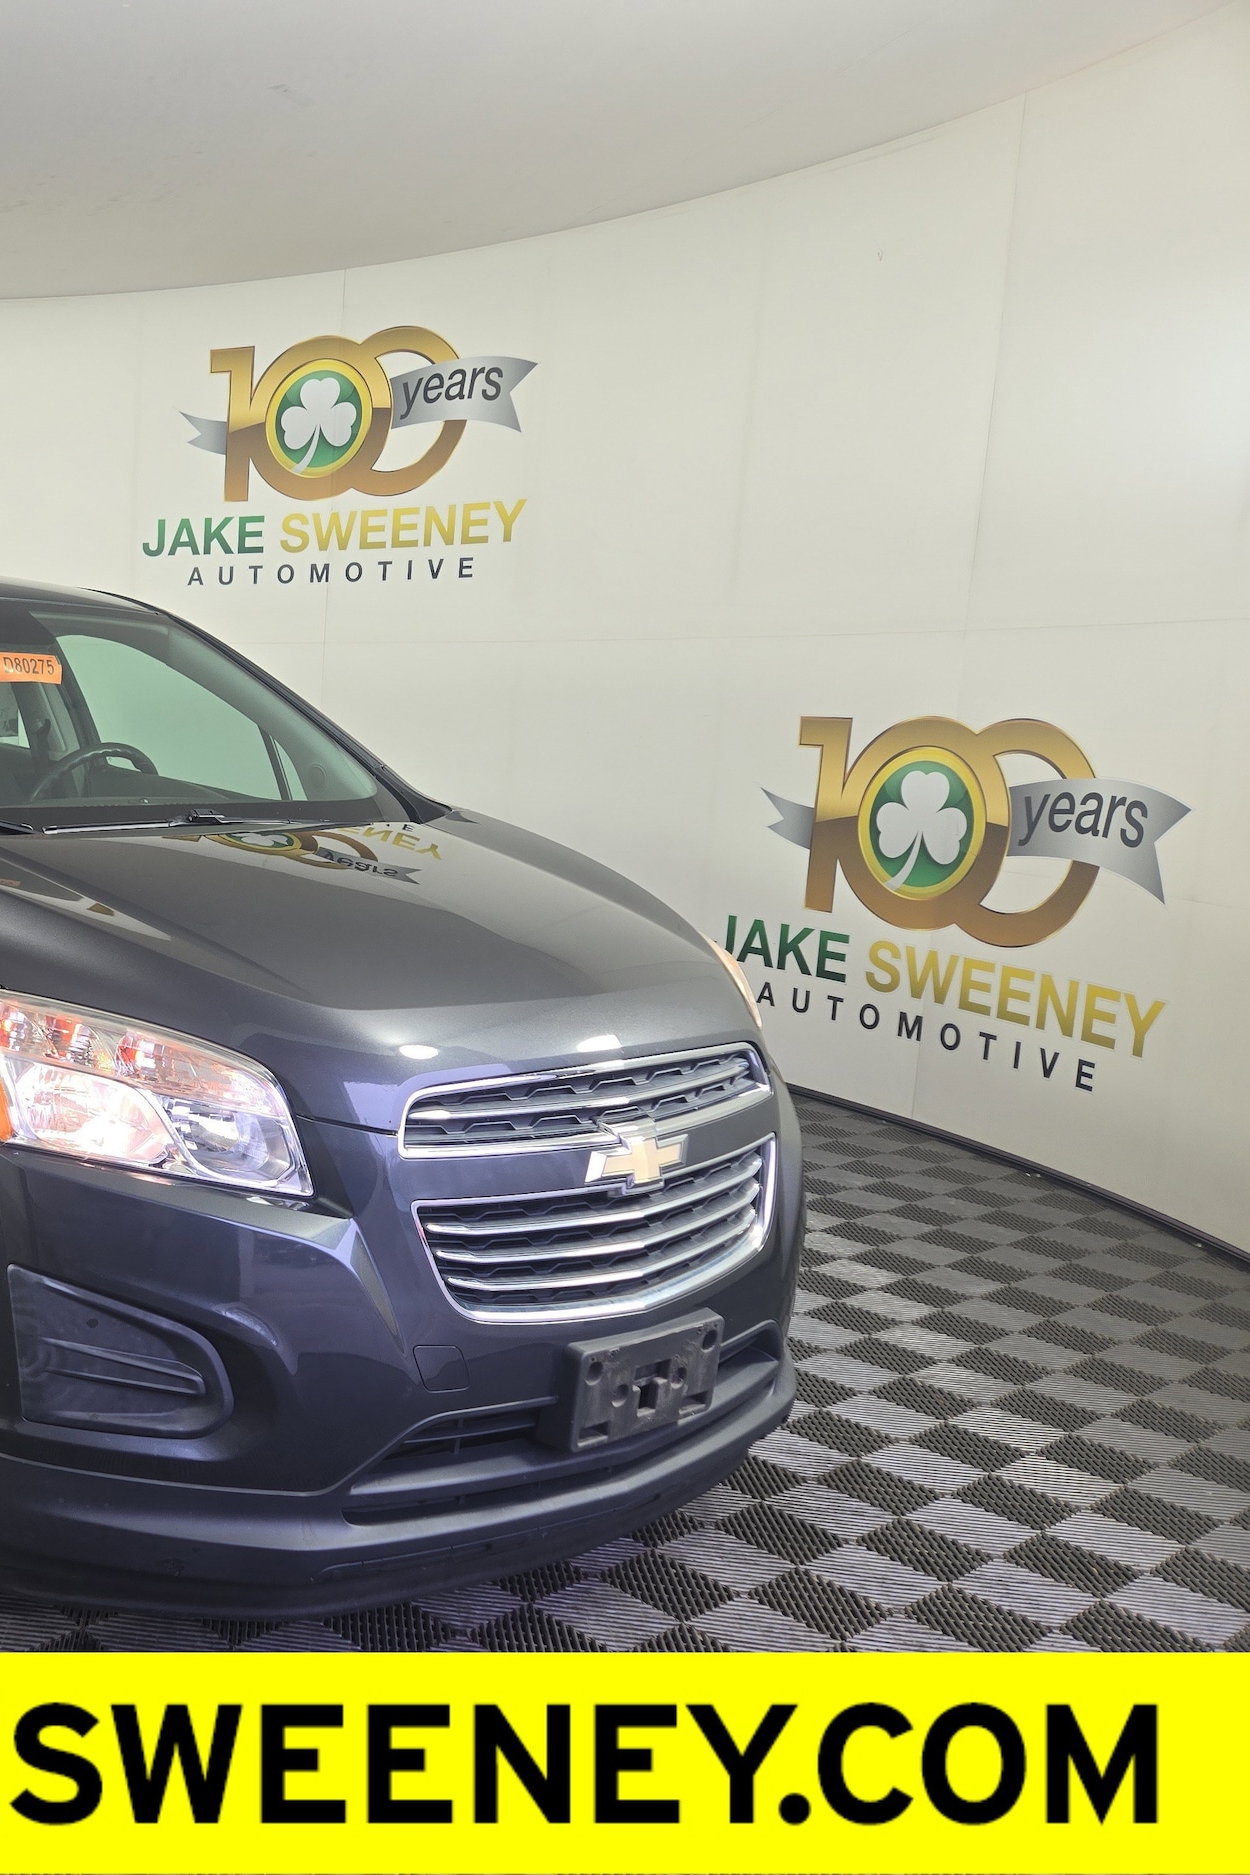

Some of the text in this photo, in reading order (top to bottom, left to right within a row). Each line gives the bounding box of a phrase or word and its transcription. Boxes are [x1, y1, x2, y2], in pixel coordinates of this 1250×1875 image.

[399, 364, 503, 420] years
[142, 498, 528, 558] JAKE SWEENEY
[188, 556, 475, 586] AUTOMOTIVE
[3, 656, 55, 676] D80275
[1018, 791, 1148, 848] years
[865, 940, 1166, 1059] SWEENEY
[756, 981, 1095, 1092] AUTOMOTIVE
